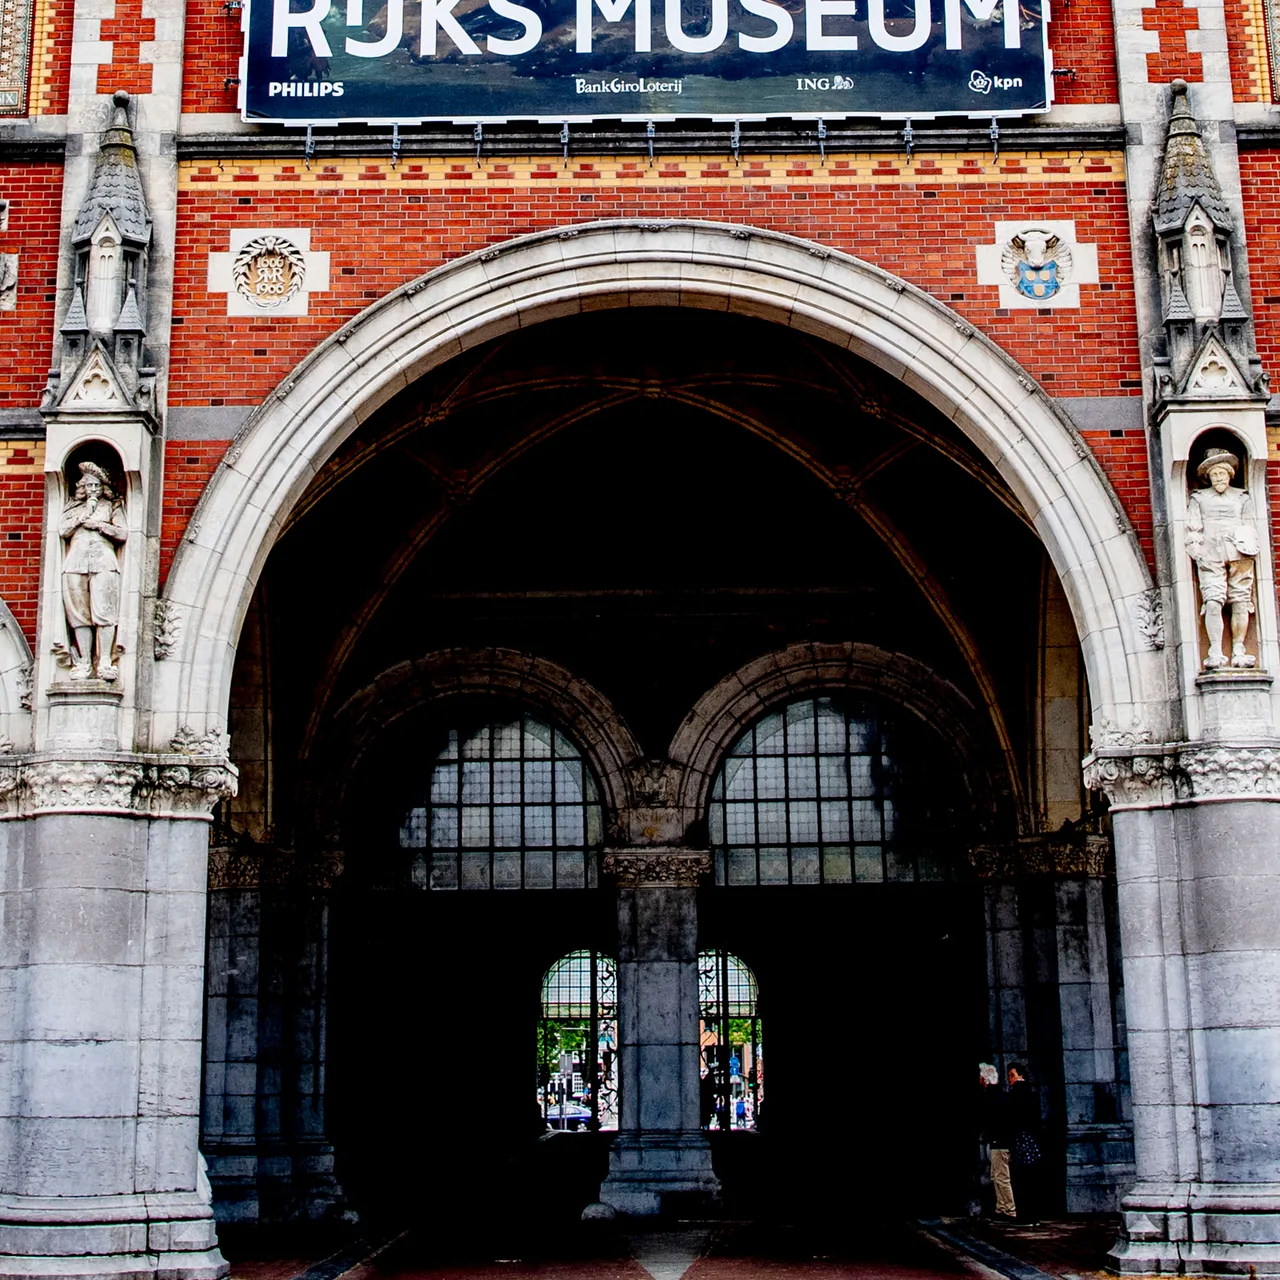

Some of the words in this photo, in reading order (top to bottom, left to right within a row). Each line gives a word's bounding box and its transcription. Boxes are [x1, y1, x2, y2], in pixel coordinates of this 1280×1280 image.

[269, 81, 345, 97] PHILIPS
[575, 77, 683, 95] BankGiroLoterij
[796, 78, 831, 91] ING
[994, 75, 1023, 90] kpn
[256, 256, 285, 269] 1606
[256, 283, 285, 296] 1906
